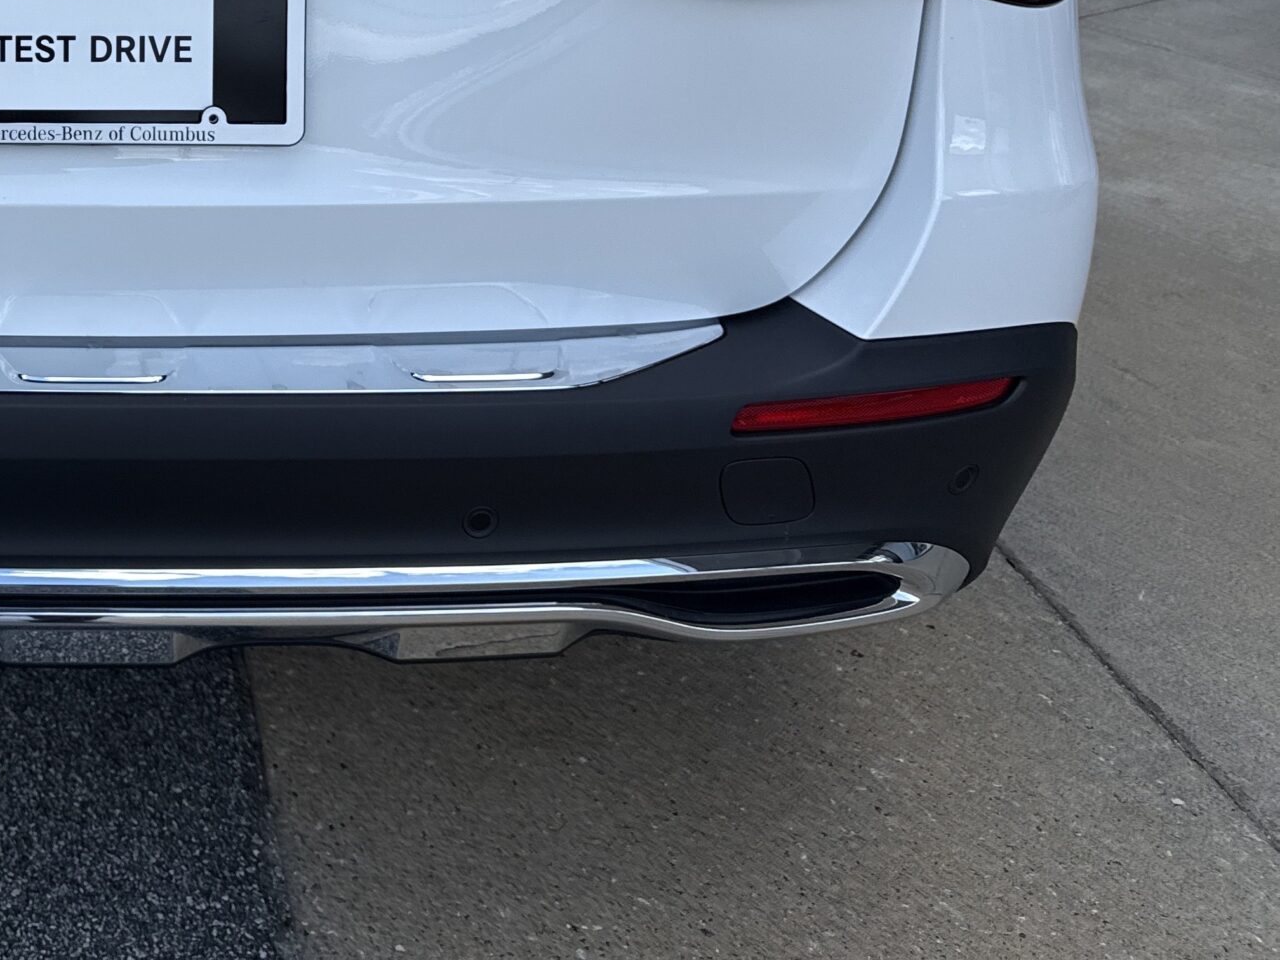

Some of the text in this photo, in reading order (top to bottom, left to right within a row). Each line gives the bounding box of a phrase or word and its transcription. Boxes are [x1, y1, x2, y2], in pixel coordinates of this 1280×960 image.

[90, 35, 193, 63] DRIVE
[108, 126, 125, 141] of
[130, 126, 216, 142] Columbus
